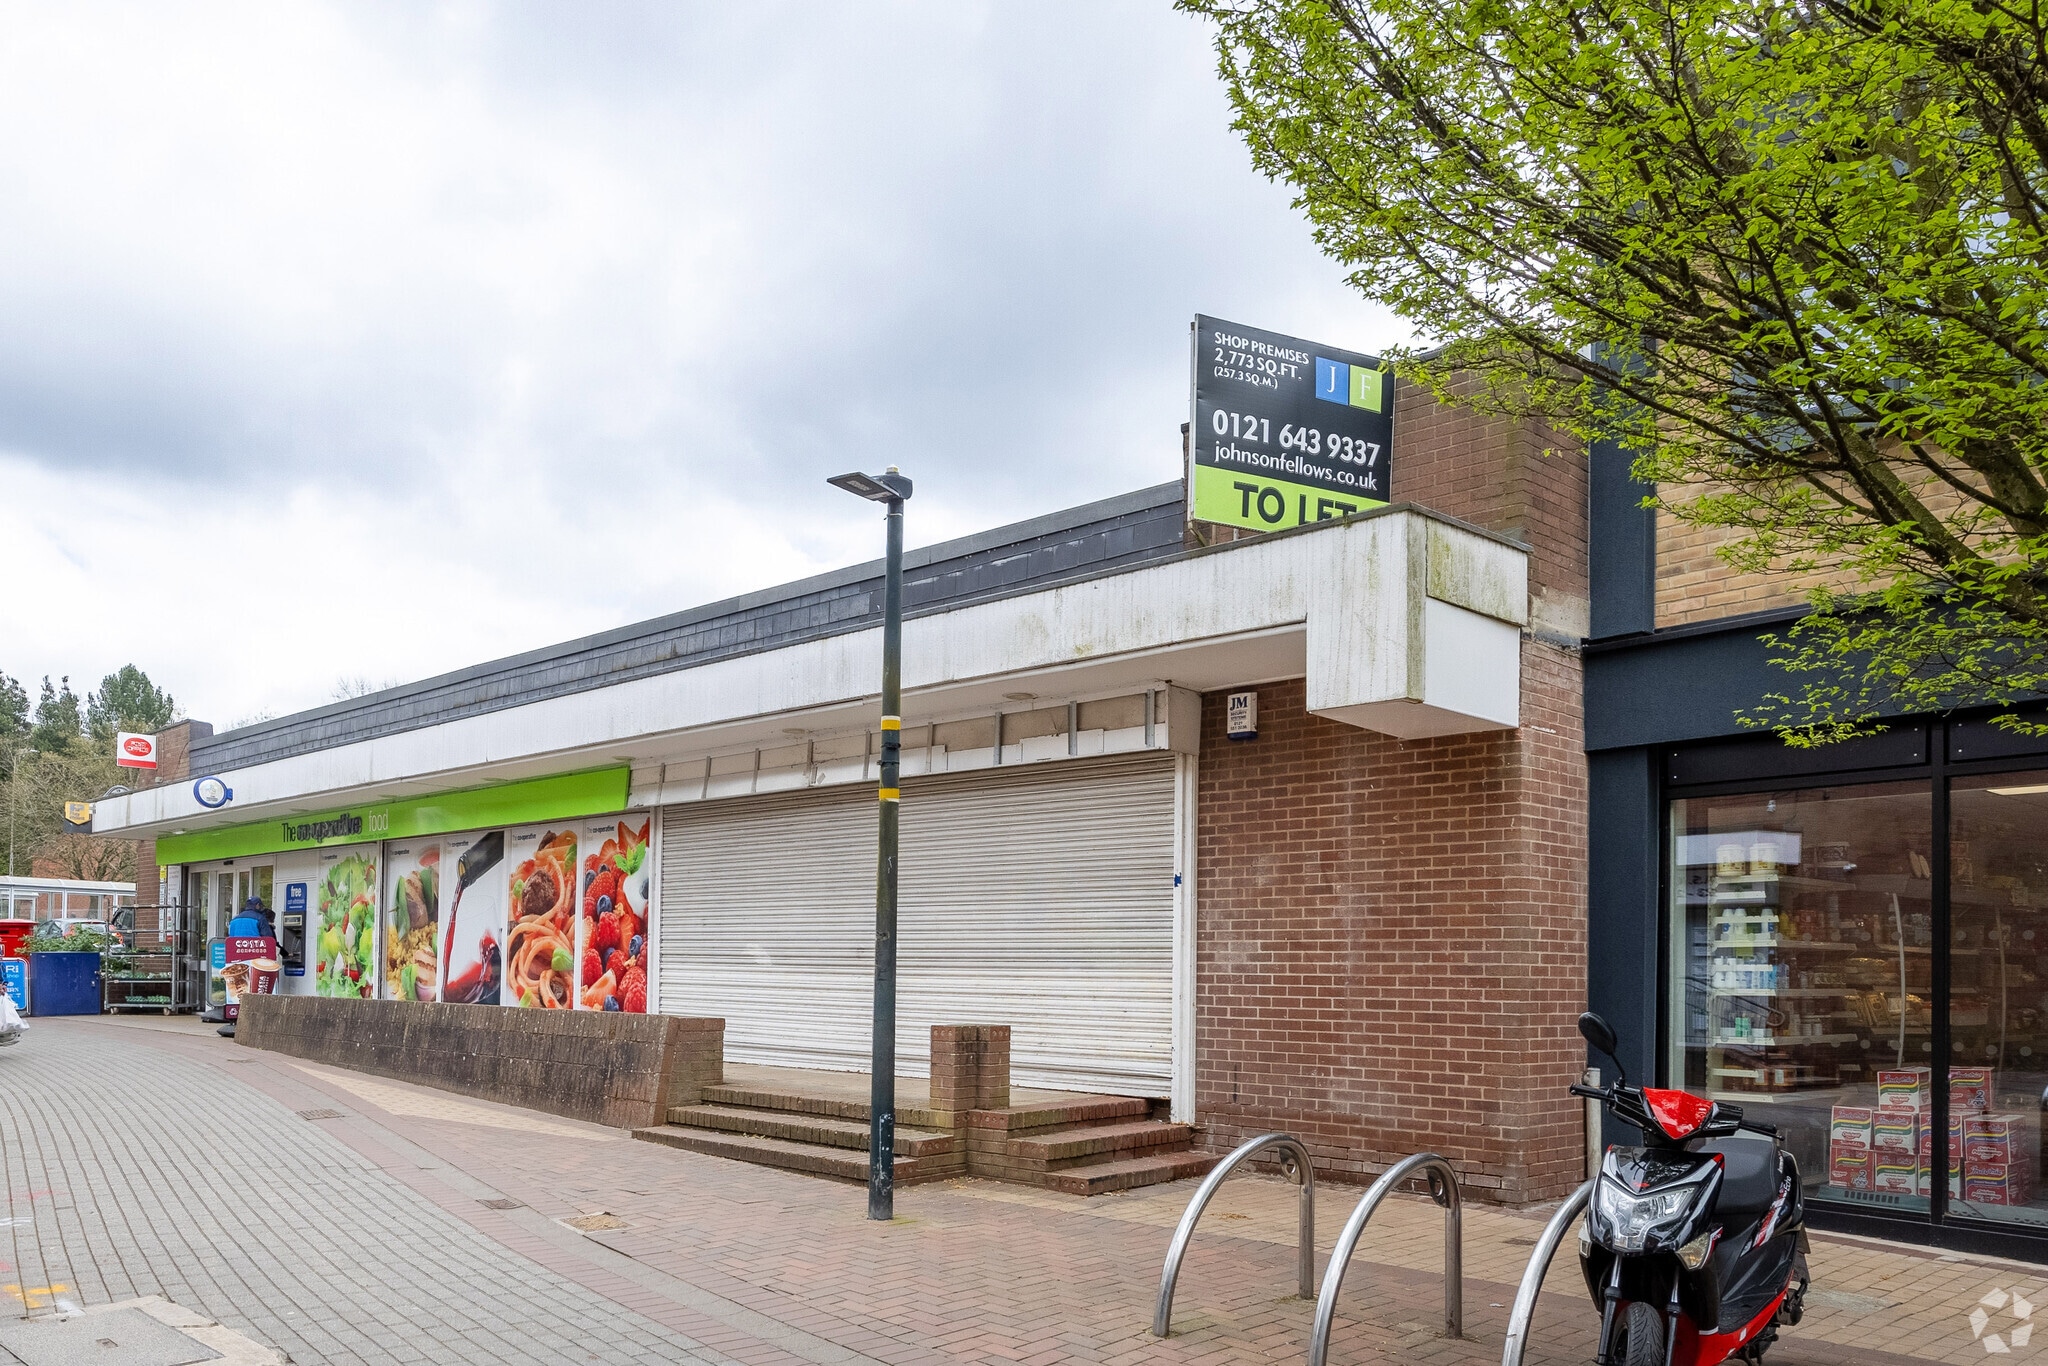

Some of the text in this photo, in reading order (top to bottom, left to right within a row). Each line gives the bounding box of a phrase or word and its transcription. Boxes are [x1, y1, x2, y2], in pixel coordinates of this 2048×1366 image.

[1214, 331, 1310, 365] SHOP PREMISES
[1214, 347, 1254, 369] 2,773
[1326, 365, 1372, 400] J F
[1212, 409, 1380, 468] 0121 643 9337
[1213, 440, 1378, 491] johnsonfellows.co.uk
[1233, 480, 1285, 524] TO
[1230, 696, 1248, 711] JM
[281, 822, 296, 843] The
[368, 808, 389, 832] food
[290, 885, 302, 898] free
[235, 939, 267, 949] COSTA
